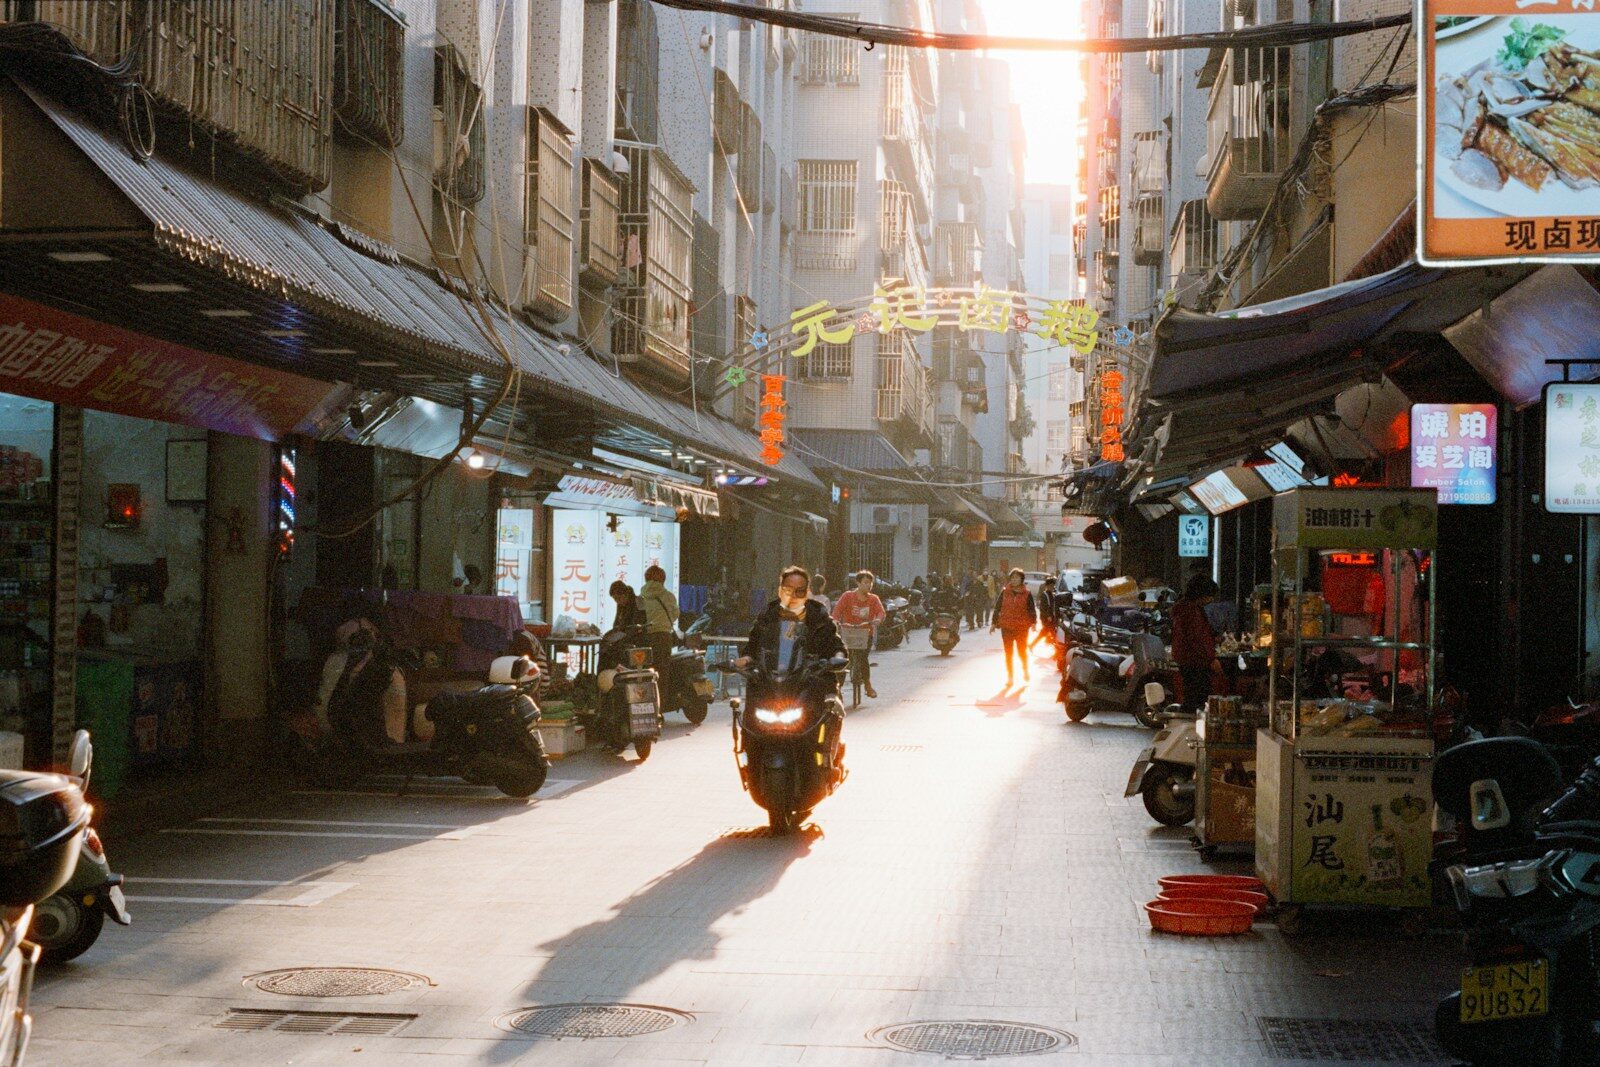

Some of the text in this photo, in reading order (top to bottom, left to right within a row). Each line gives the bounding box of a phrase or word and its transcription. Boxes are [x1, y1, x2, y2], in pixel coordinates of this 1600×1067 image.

[791, 283, 1098, 356] 元记卤鹅
[1421, 411, 1486, 438] 琥珀
[1416, 445, 1492, 469] 发艺阁
[1303, 793, 1345, 870] 汕尾
[1465, 987, 1541, 1020] 9U832
